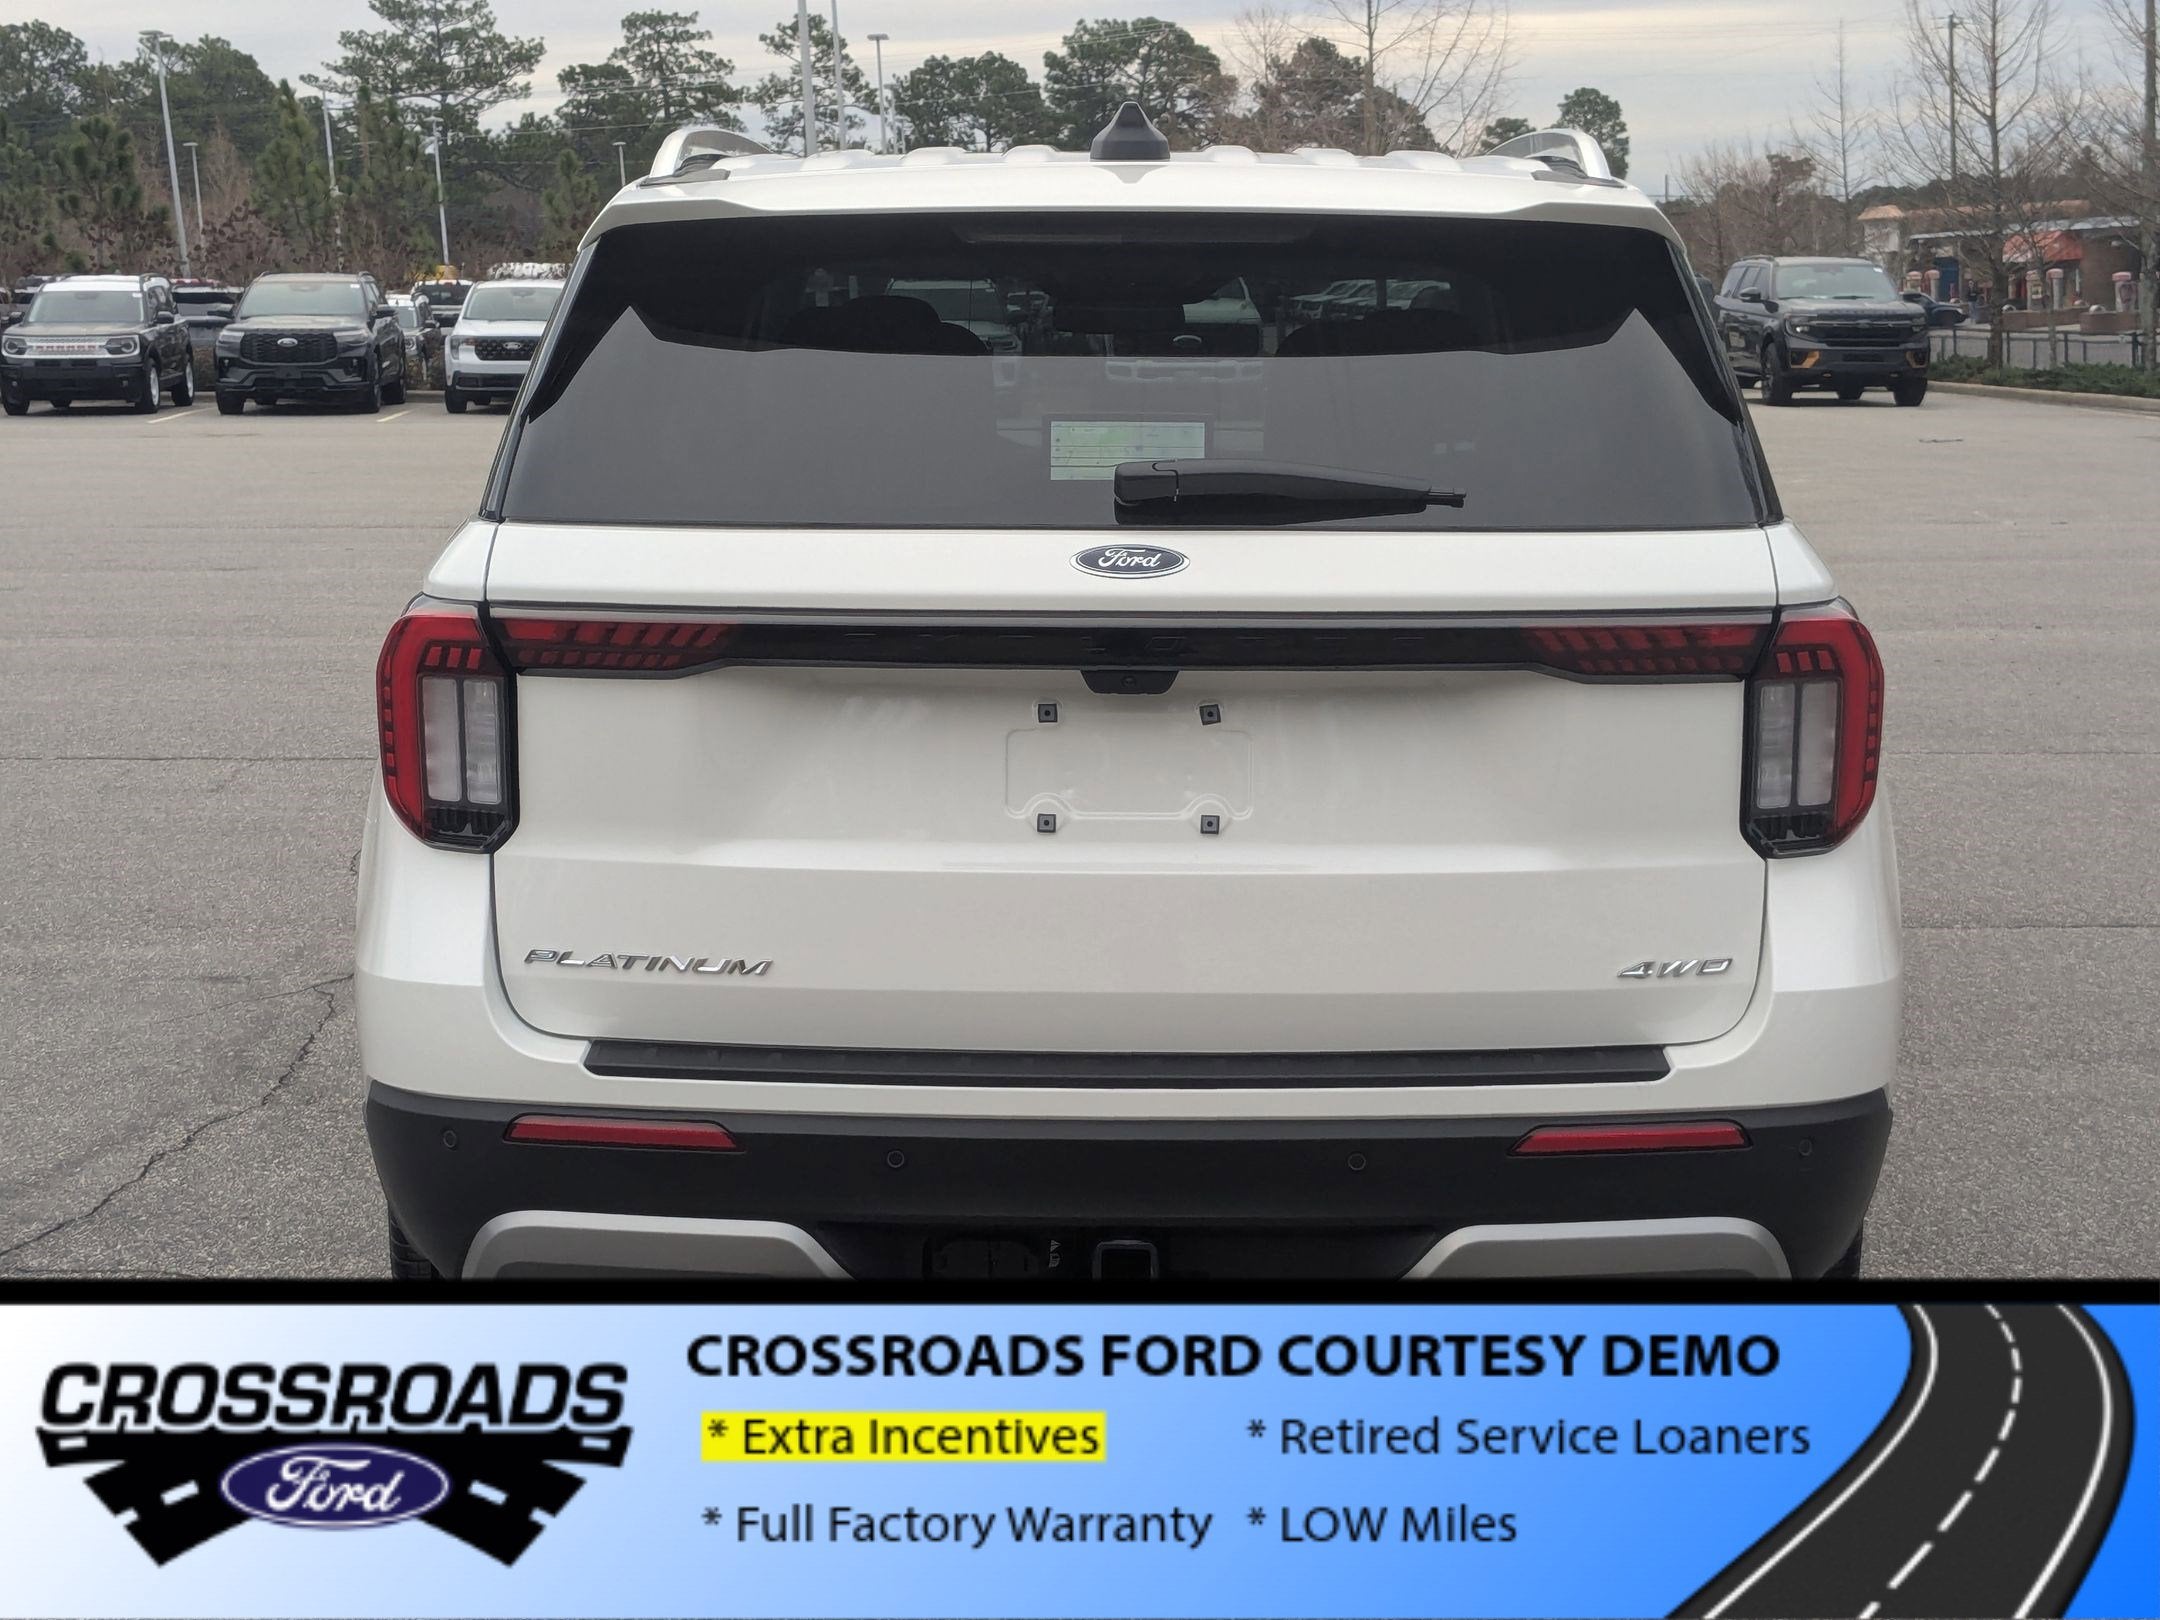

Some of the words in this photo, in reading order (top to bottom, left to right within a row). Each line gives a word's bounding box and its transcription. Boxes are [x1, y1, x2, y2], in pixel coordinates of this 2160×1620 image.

[1098, 547, 1162, 568] Ford
[524, 948, 774, 977] PLATINUM
[1617, 958, 1733, 979] 4WD
